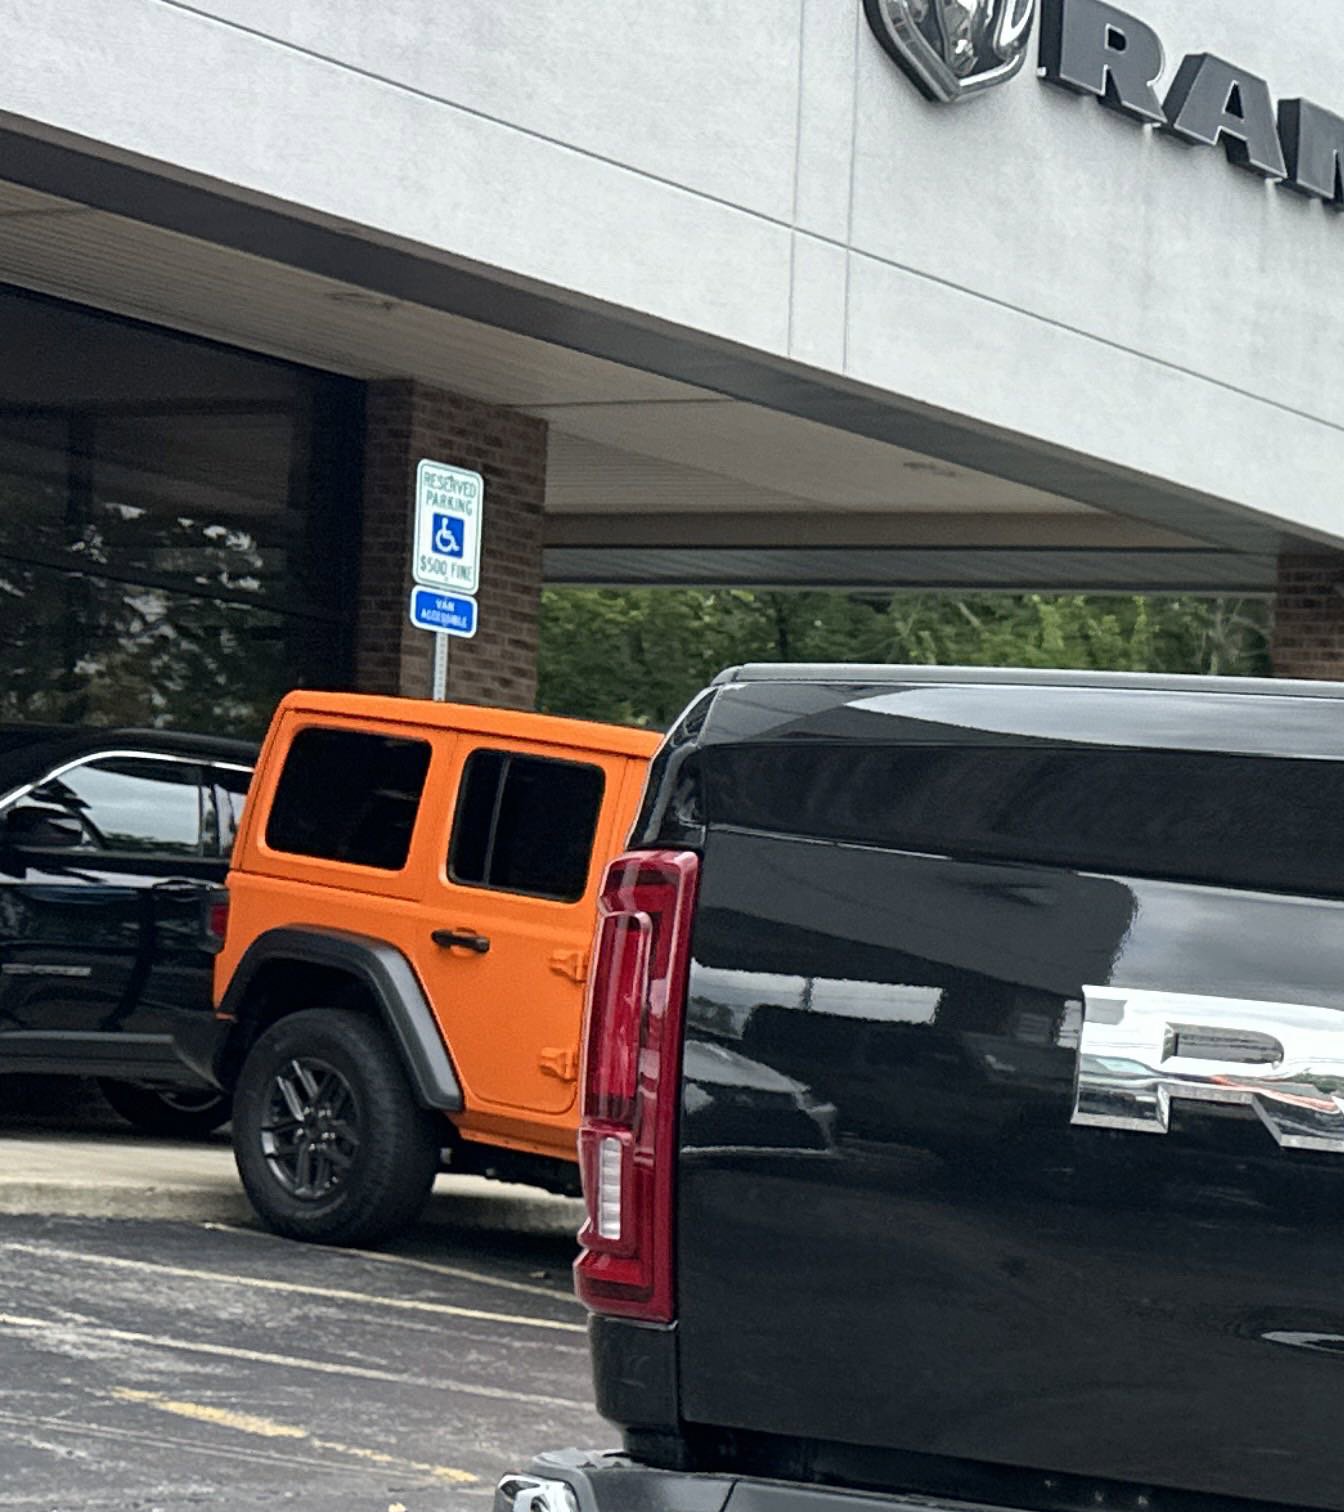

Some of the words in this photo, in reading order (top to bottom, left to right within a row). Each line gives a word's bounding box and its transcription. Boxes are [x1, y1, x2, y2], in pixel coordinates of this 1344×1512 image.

[424, 471, 476, 498] RESERVED
[426, 490, 473, 516] PARKING
[420, 555, 447, 576] $500
[451, 565, 472, 582] FINE
[435, 598, 455, 612] VAN
